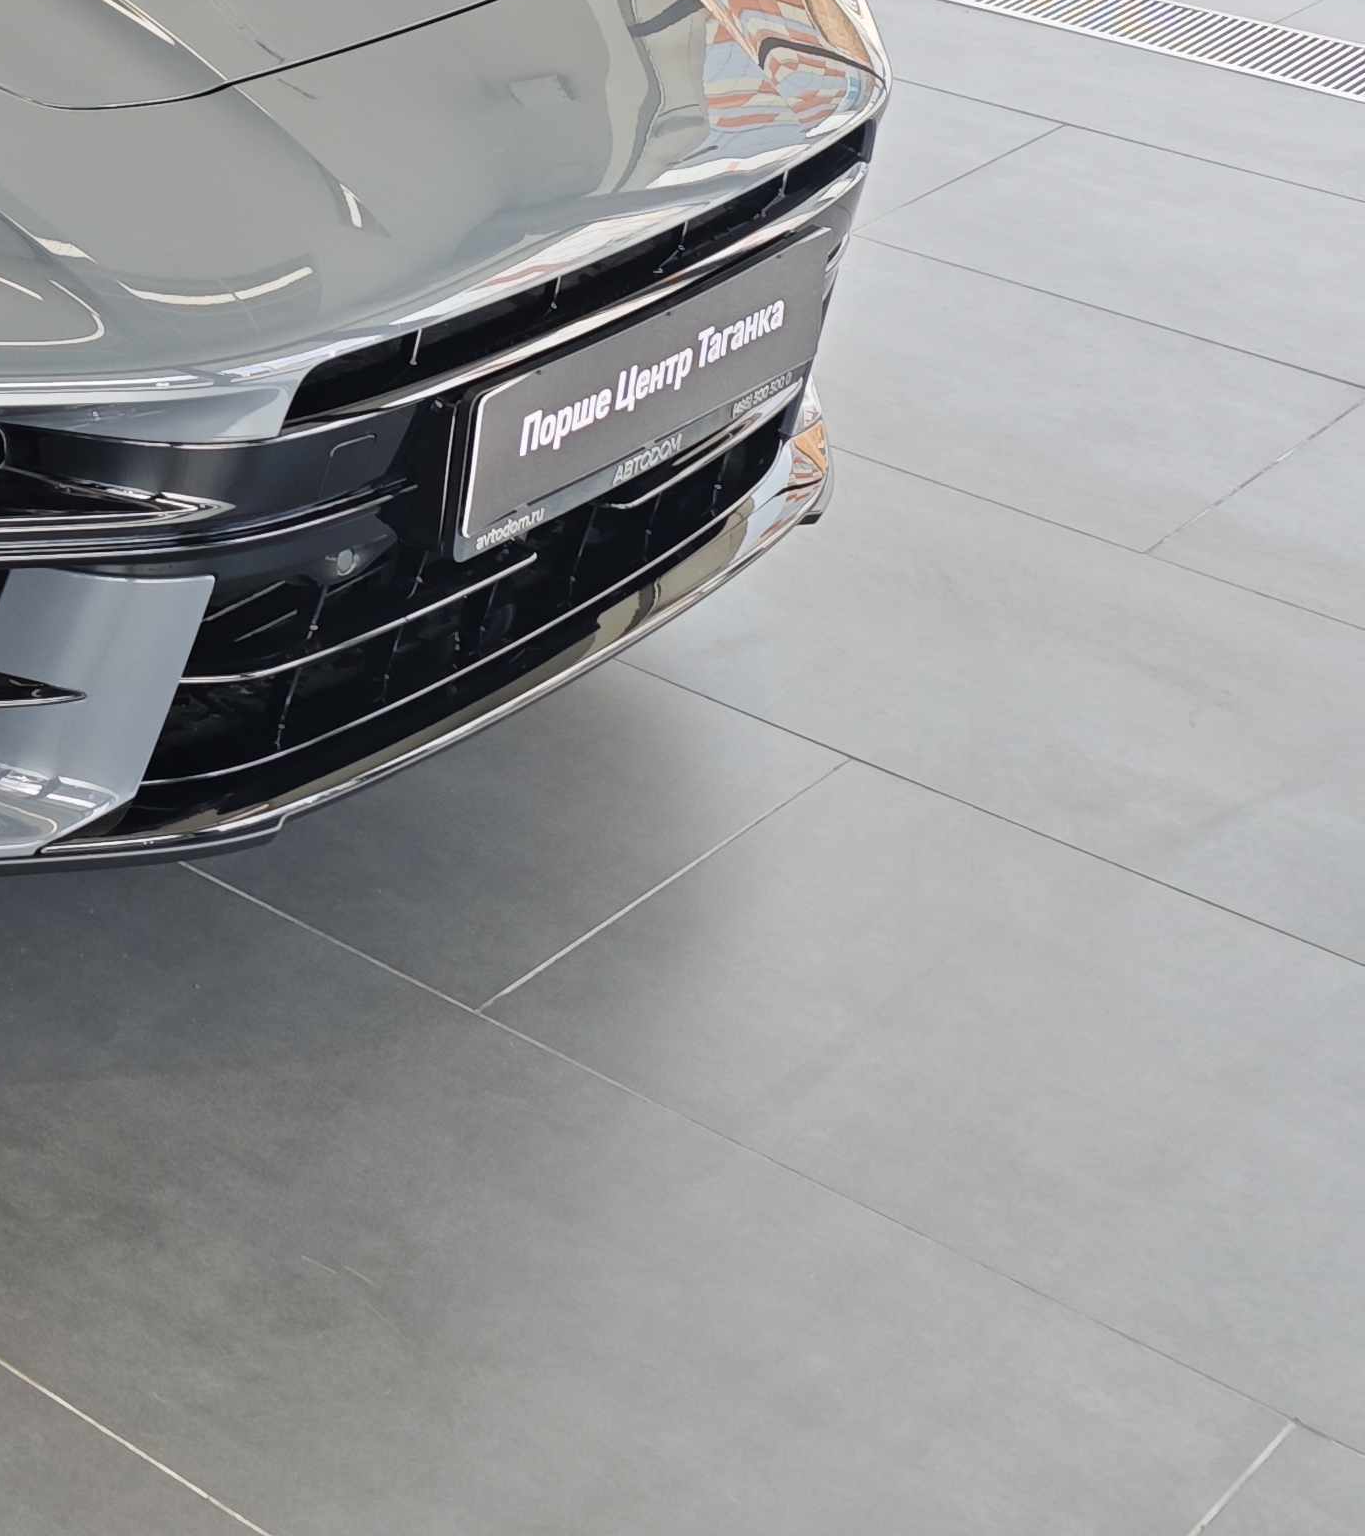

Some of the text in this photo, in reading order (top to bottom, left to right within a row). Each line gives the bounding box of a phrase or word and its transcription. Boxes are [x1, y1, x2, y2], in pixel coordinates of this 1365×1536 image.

[519, 299, 786, 457] Порше Центр Таганка
[785, 371, 793, 386] 0
[475, 507, 546, 551] avtodom.ru
